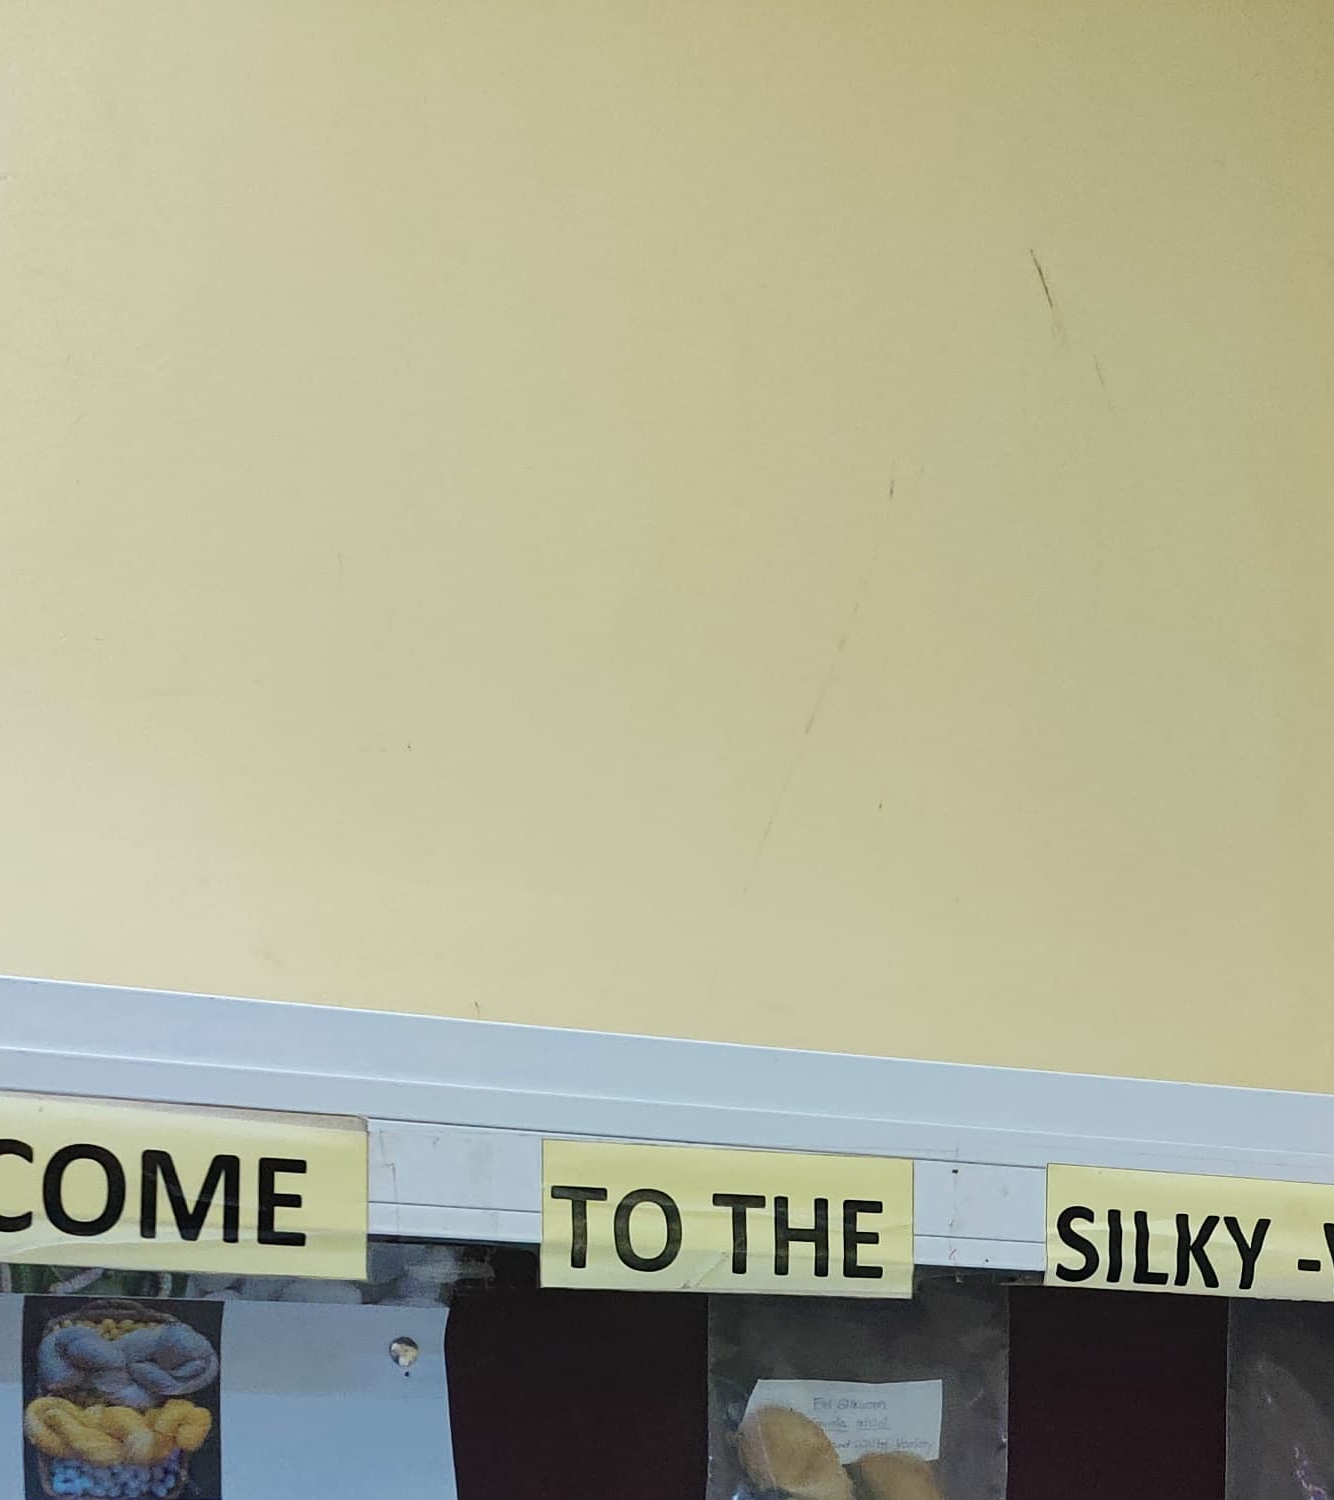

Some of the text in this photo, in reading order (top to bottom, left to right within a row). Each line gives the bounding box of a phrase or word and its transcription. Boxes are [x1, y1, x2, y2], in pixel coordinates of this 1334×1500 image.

[551, 1185, 884, 1279] TO THE
[1055, 1205, 1271, 1290] SILKY
